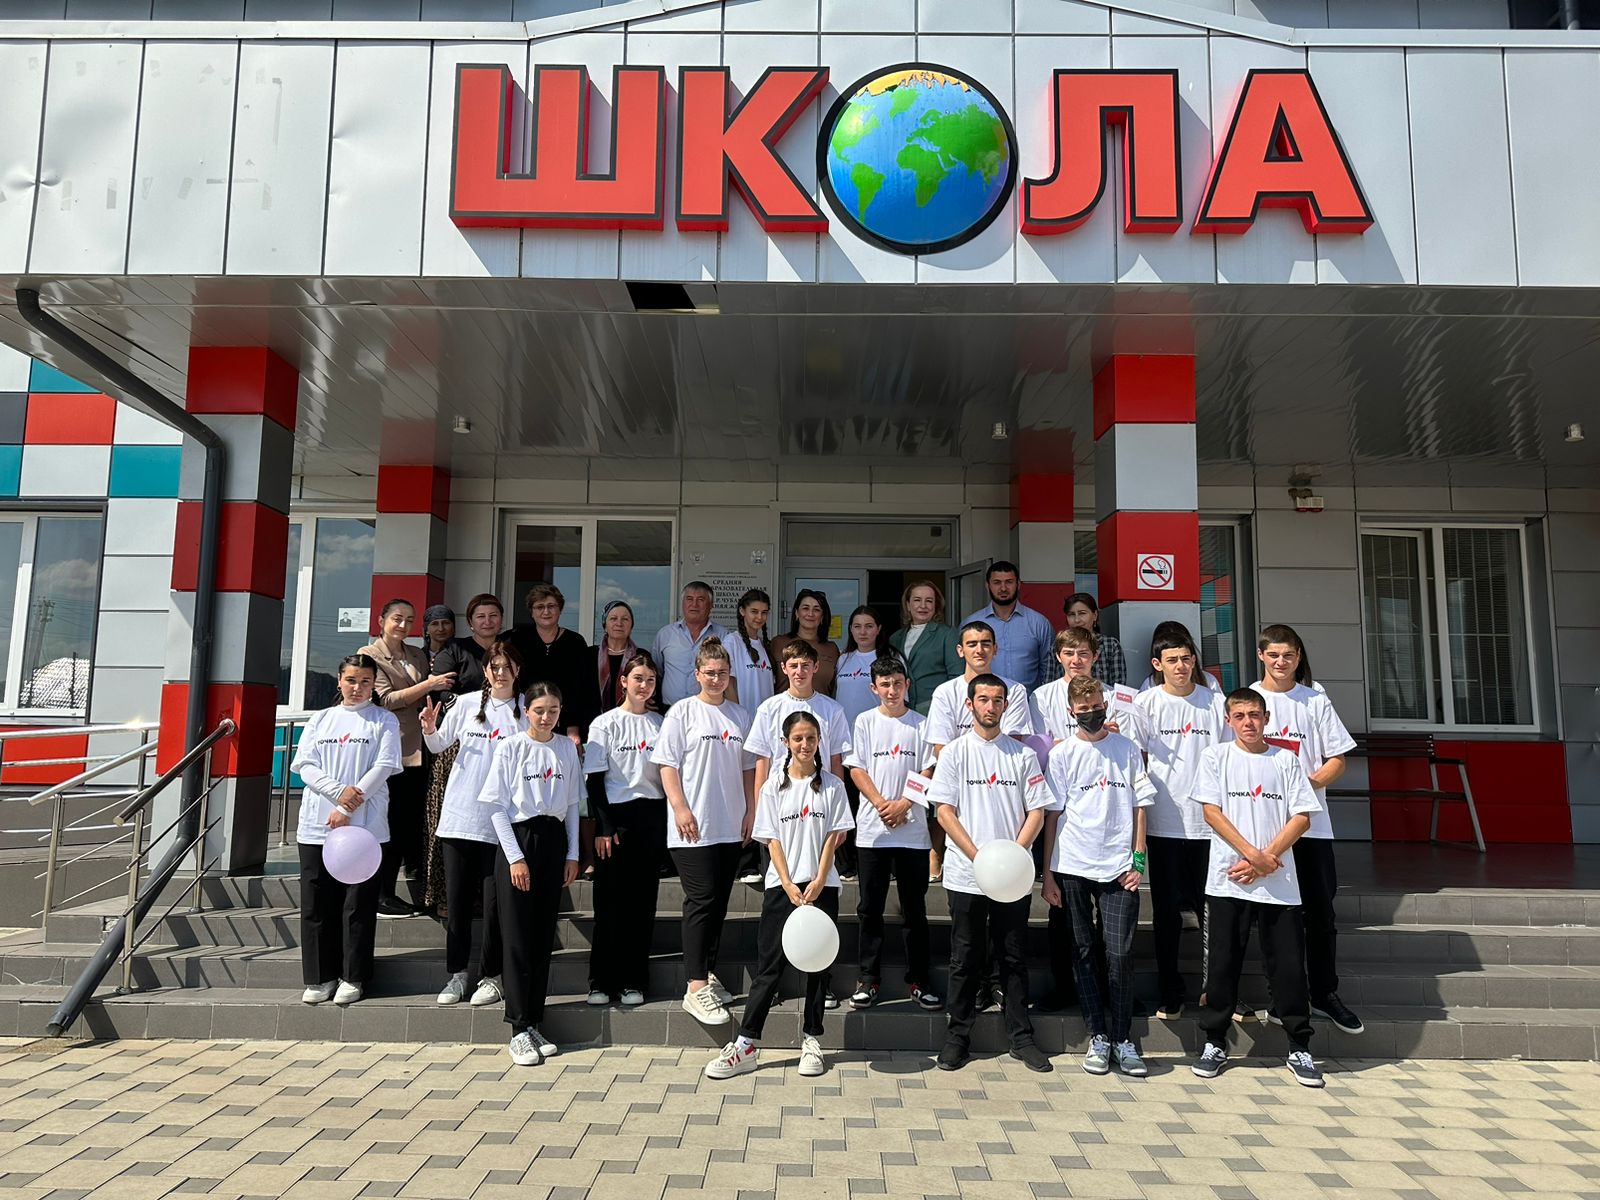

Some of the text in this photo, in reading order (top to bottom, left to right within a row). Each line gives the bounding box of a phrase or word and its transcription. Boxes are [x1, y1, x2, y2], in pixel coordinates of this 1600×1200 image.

[450, 62, 1373, 255] ШКОЛА
[467, 731, 487, 739] ТОЧКА
[1262, 792, 1283, 800] РОСТА
[780, 811, 826, 823] ТОЧКА РОСТА
